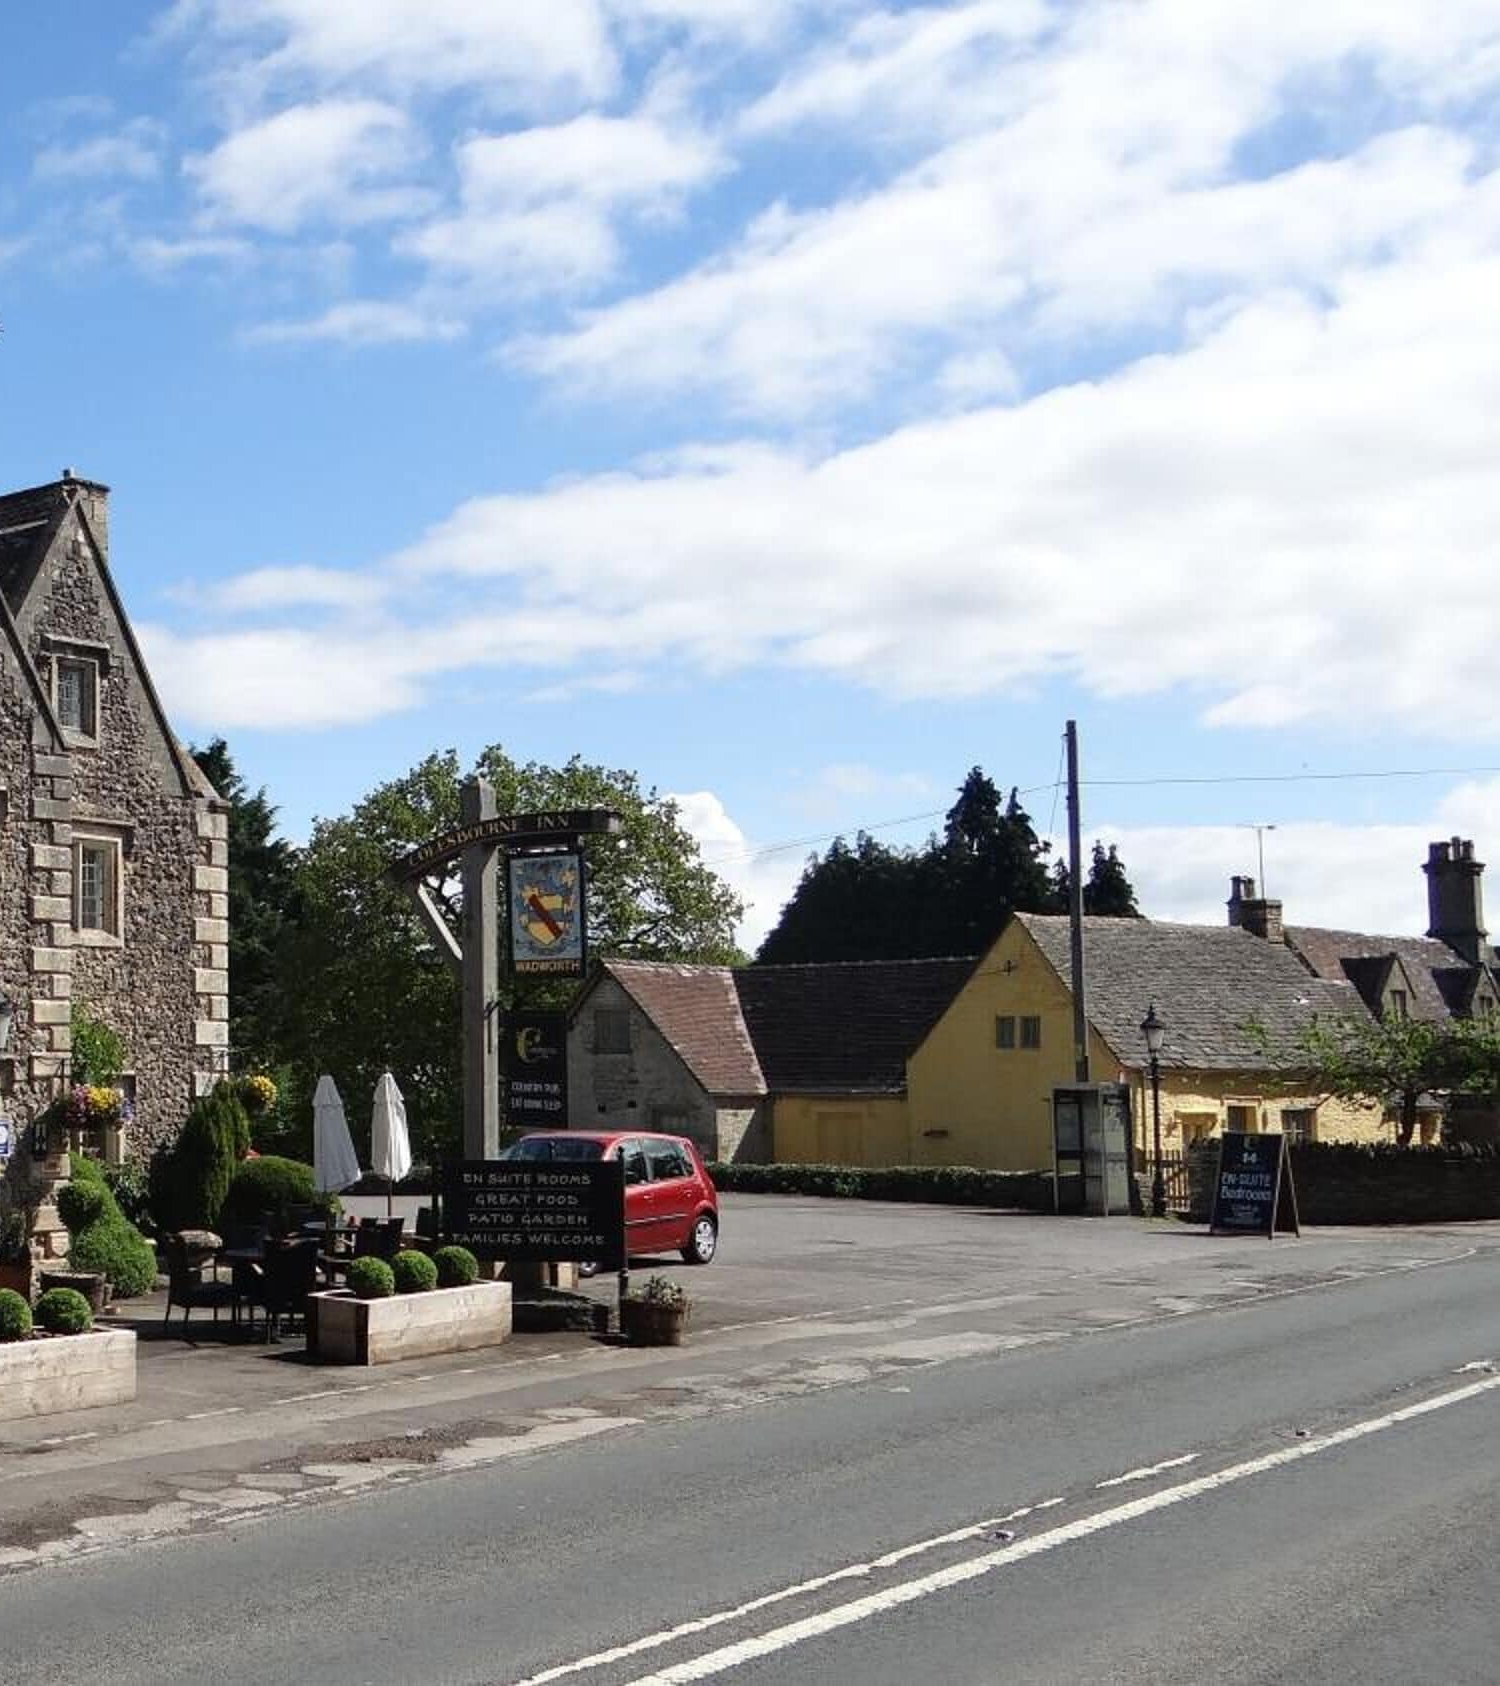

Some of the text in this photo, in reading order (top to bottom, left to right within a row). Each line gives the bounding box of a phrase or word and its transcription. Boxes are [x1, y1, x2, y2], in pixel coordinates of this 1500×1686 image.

[537, 815, 570, 829] INN
[463, 1173, 591, 1185] EN SUITE ROOMS
[475, 1194, 580, 1206] GREAT FOOD
[468, 1214, 587, 1225] PATIO GARDEN
[452, 1233, 605, 1246] FAMILIES WELCOME
